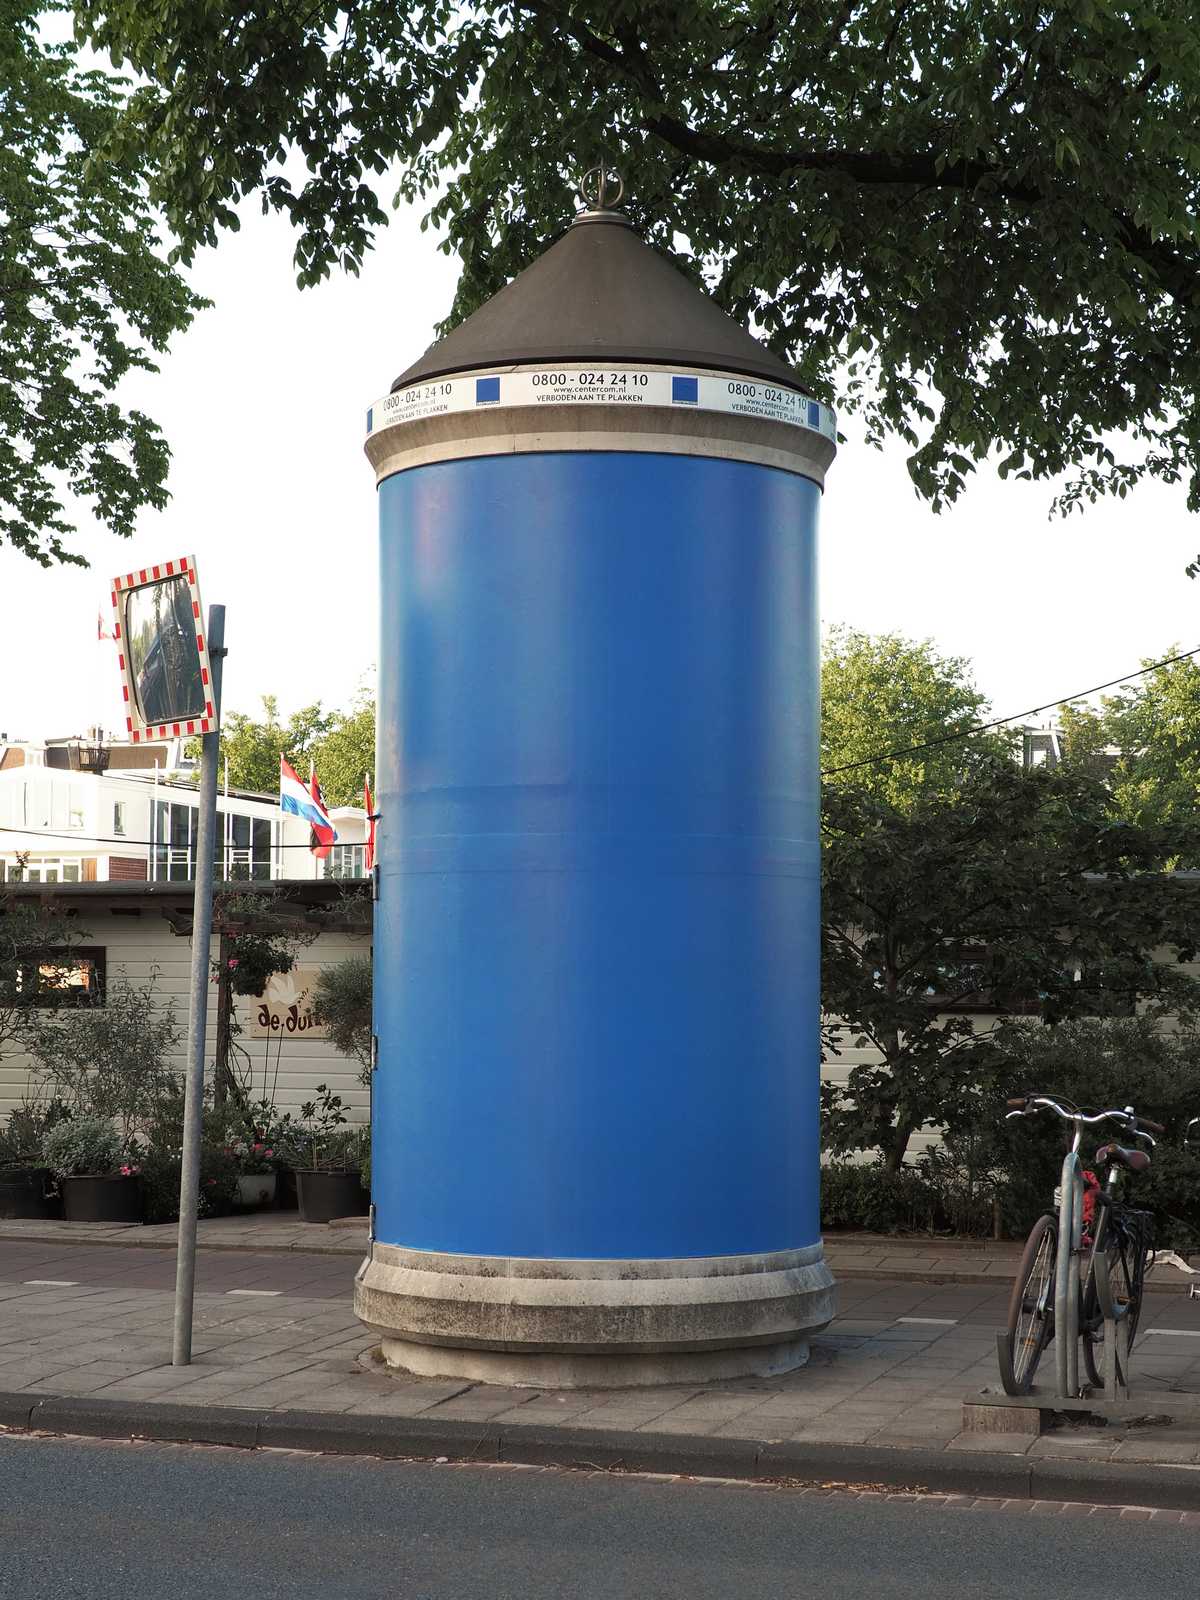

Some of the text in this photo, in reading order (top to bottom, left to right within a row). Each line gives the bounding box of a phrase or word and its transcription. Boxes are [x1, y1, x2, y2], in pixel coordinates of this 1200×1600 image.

[532, 373, 566, 386] 0800
[579, 373, 605, 385] 024
[610, 373, 627, 385] 24
[632, 374, 648, 386] 10
[405, 389, 421, 404] 024
[425, 386, 436, 399] 24
[440, 383, 452, 396] 10
[536, 393, 643, 402] VERBODEN AAN TE PLAKKEN
[728, 382, 756, 397] 0800
[764, 388, 782, 403] 024
[785, 393, 795, 407] 24
[798, 398, 807, 410] 10
[731, 403, 764, 415] VERBODEN
[764, 409, 776, 417] AAN
[776, 411, 783, 419] TE
[256, 1004, 280, 1031] de
